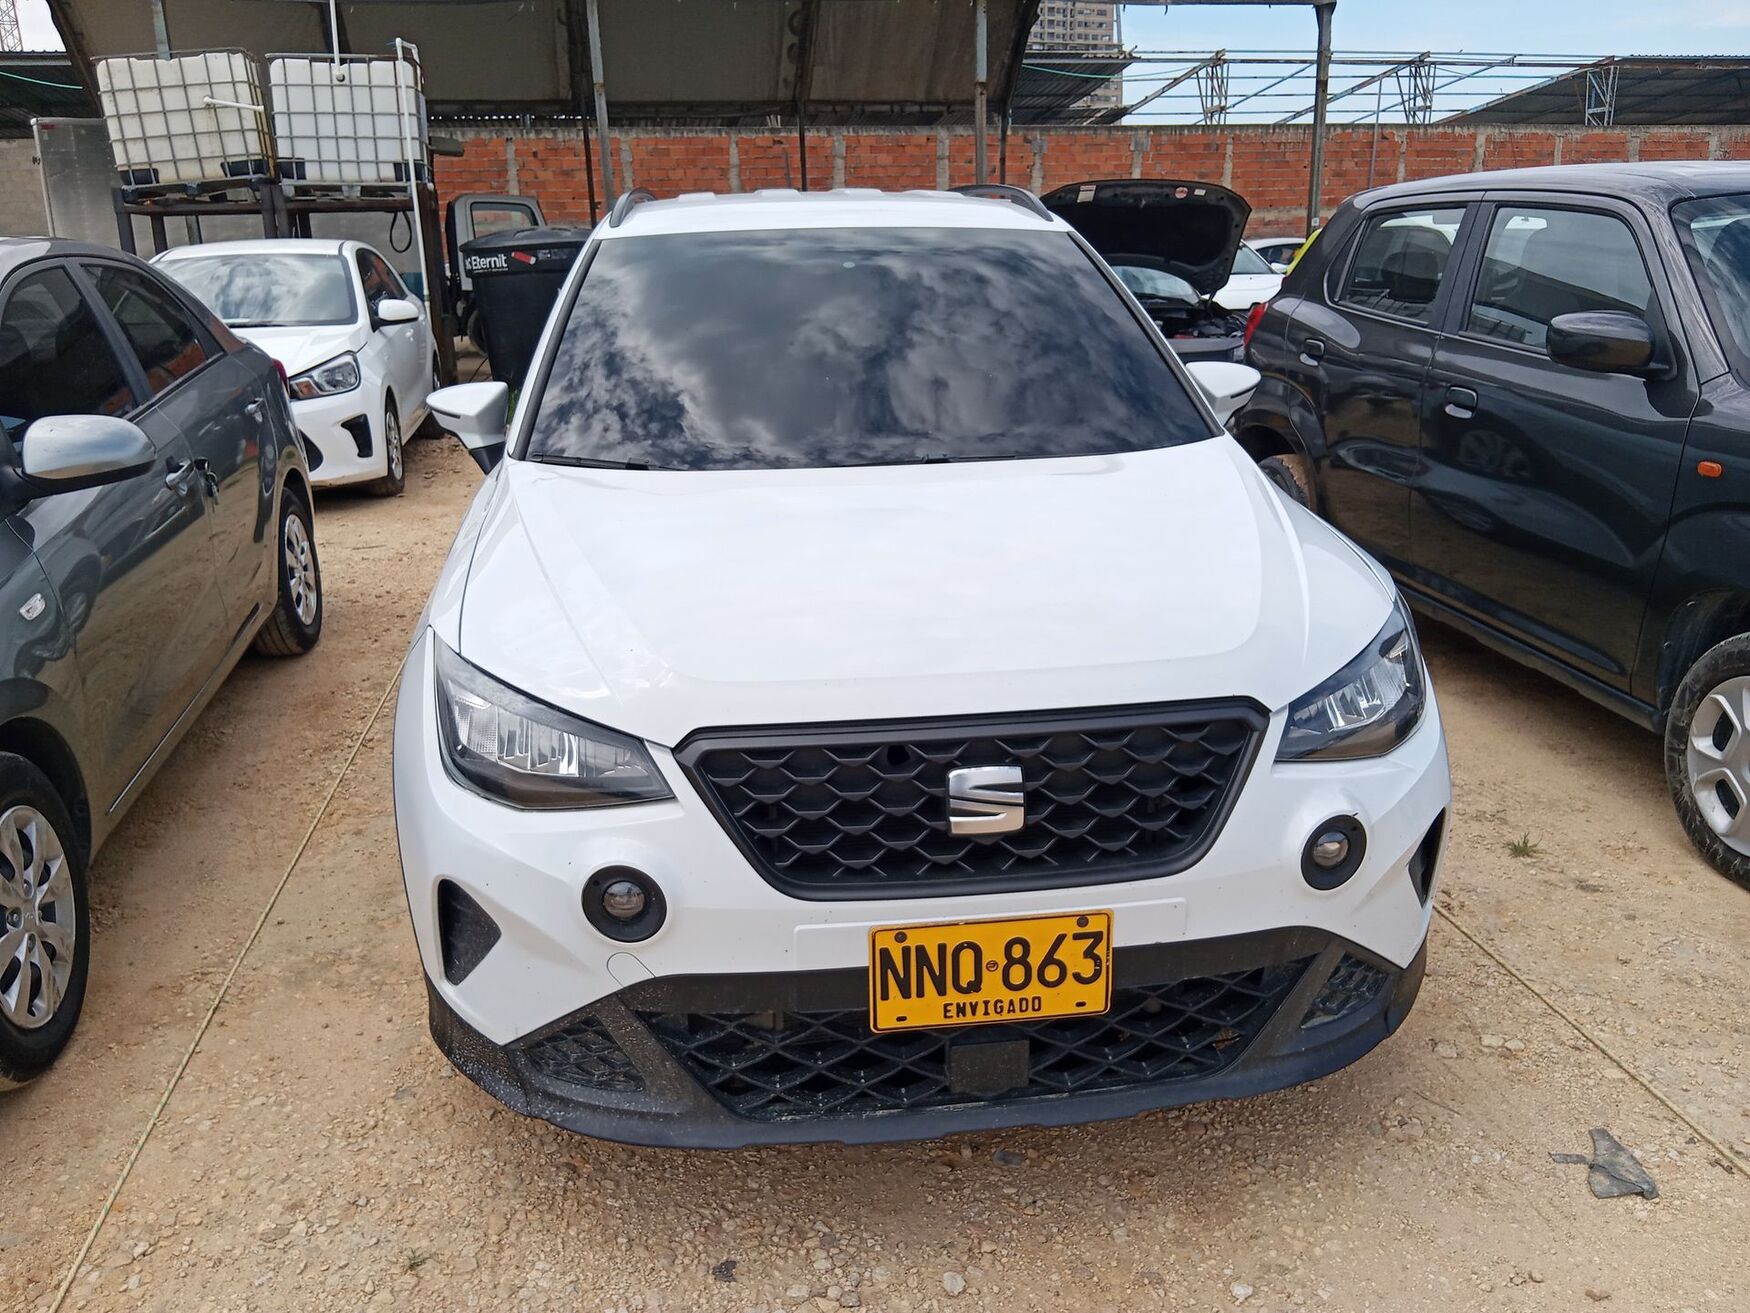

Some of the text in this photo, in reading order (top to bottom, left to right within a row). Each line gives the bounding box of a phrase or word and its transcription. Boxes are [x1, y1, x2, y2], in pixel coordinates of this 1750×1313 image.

[472, 253, 508, 270] Eternit
[880, 931, 1104, 1001] NNQ 863
[943, 996, 1042, 1019] ENVIGADO
